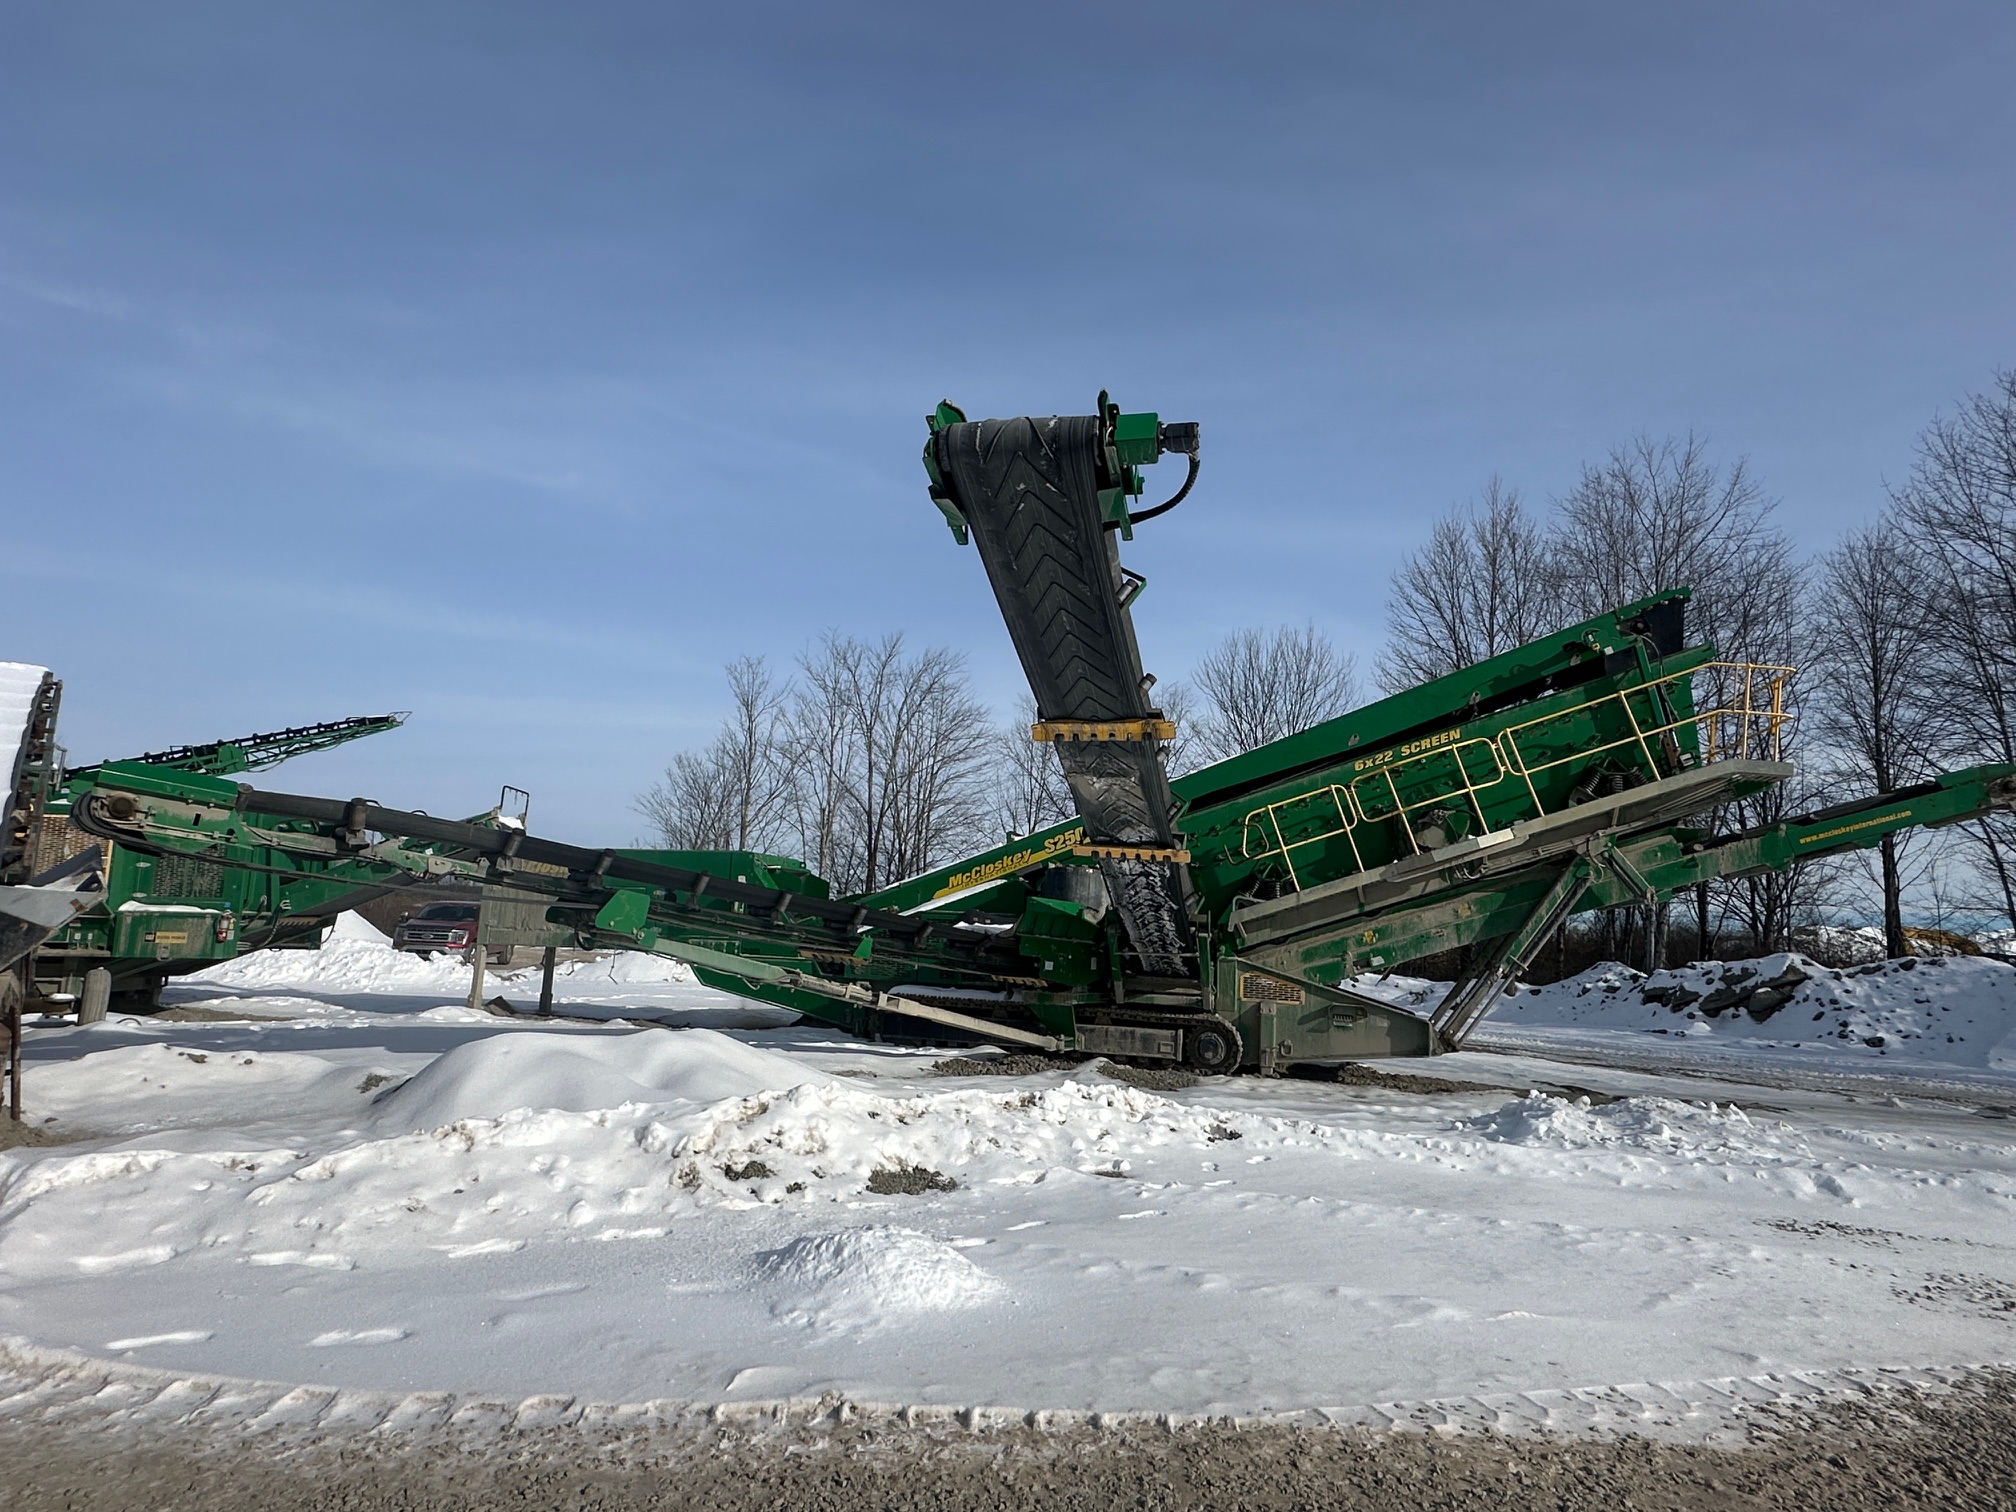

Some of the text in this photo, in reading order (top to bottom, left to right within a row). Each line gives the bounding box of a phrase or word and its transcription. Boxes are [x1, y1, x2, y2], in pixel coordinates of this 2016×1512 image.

[1354, 728, 1461, 771] 6x22 SCREEN
[1799, 810, 1912, 844] www.mccloskeyinternational.com
[949, 848, 1031, 889] McCloskey
